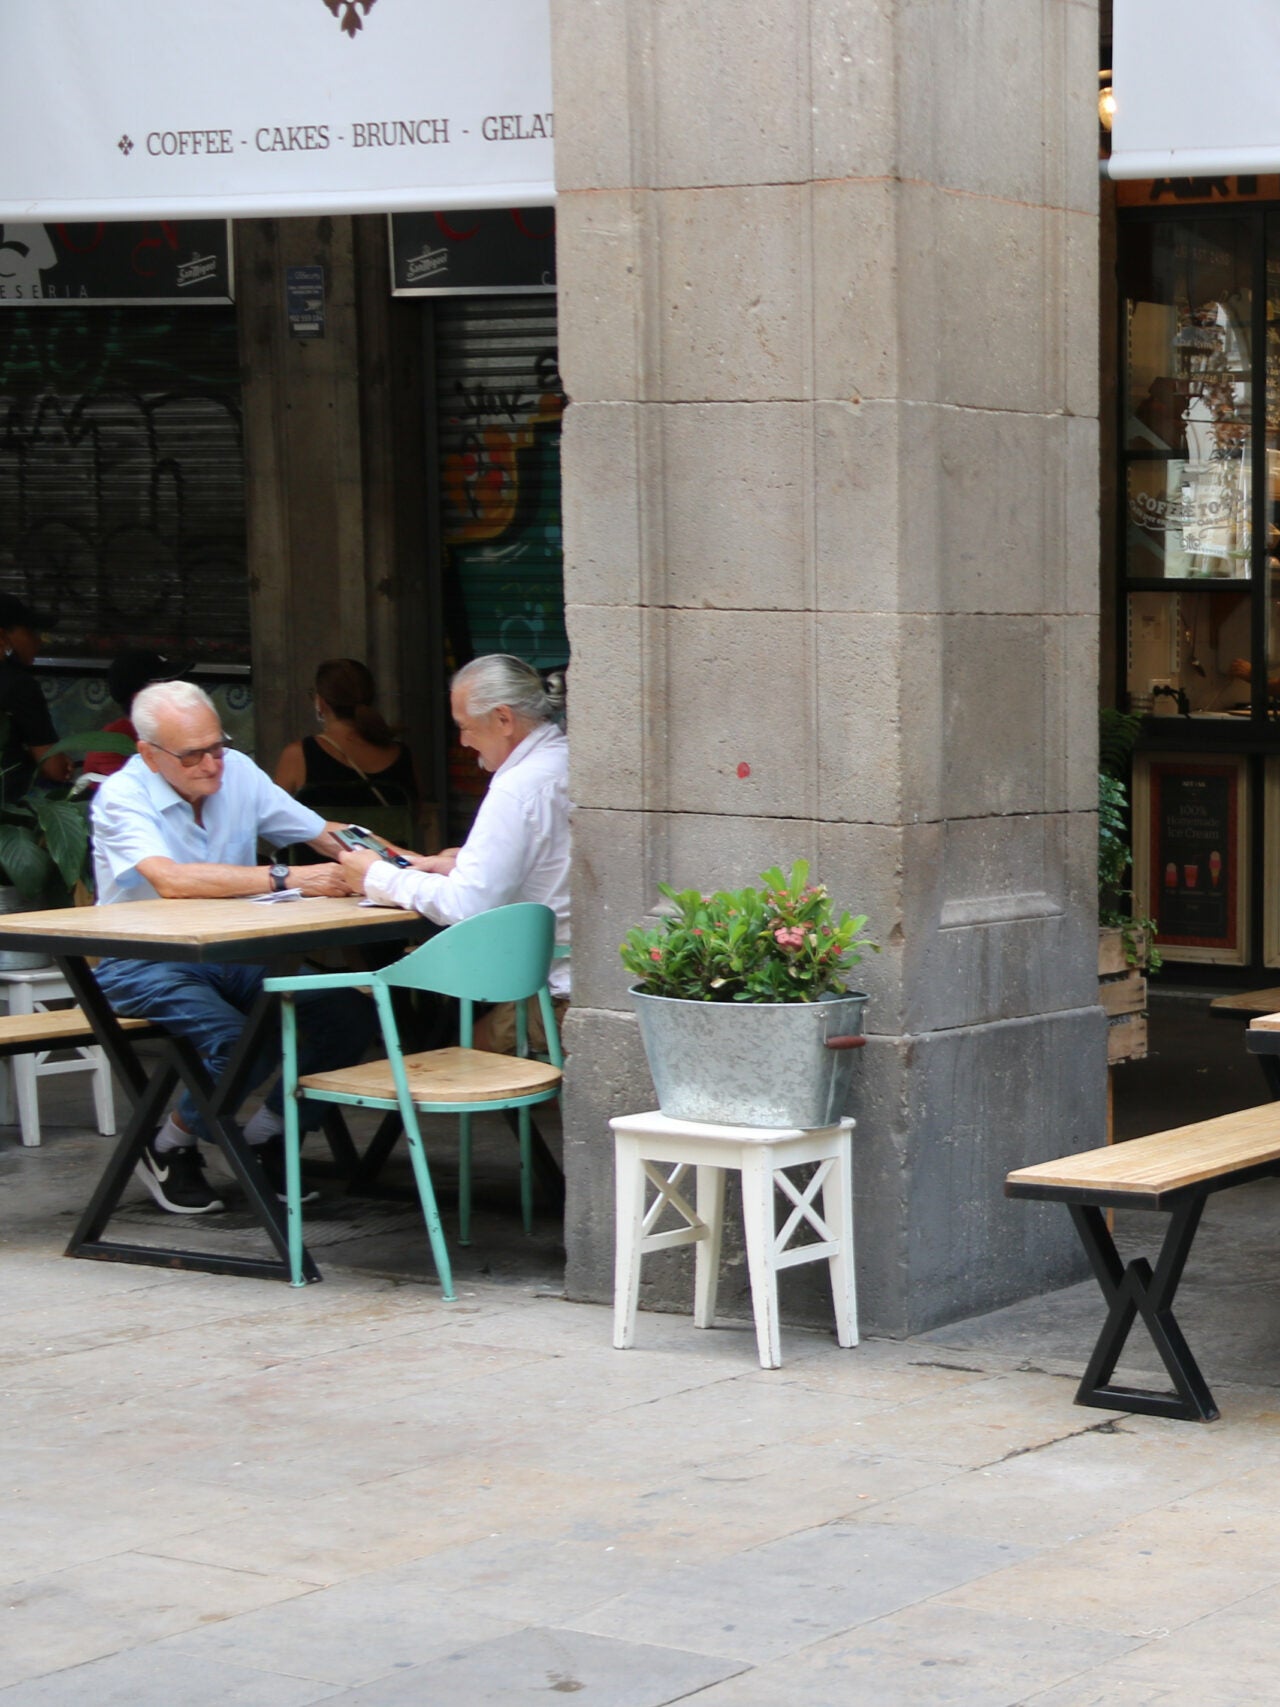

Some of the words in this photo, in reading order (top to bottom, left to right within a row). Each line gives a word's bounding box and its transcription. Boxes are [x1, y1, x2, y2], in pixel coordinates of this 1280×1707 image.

[146, 129, 233, 156] COFFEE
[255, 125, 330, 152] CAKES
[352, 118, 450, 148] BRUNCH
[1166, 815, 1220, 828] Homemade
[1167, 827, 1183, 839] Ice
[1185, 828, 1220, 840] Cream
